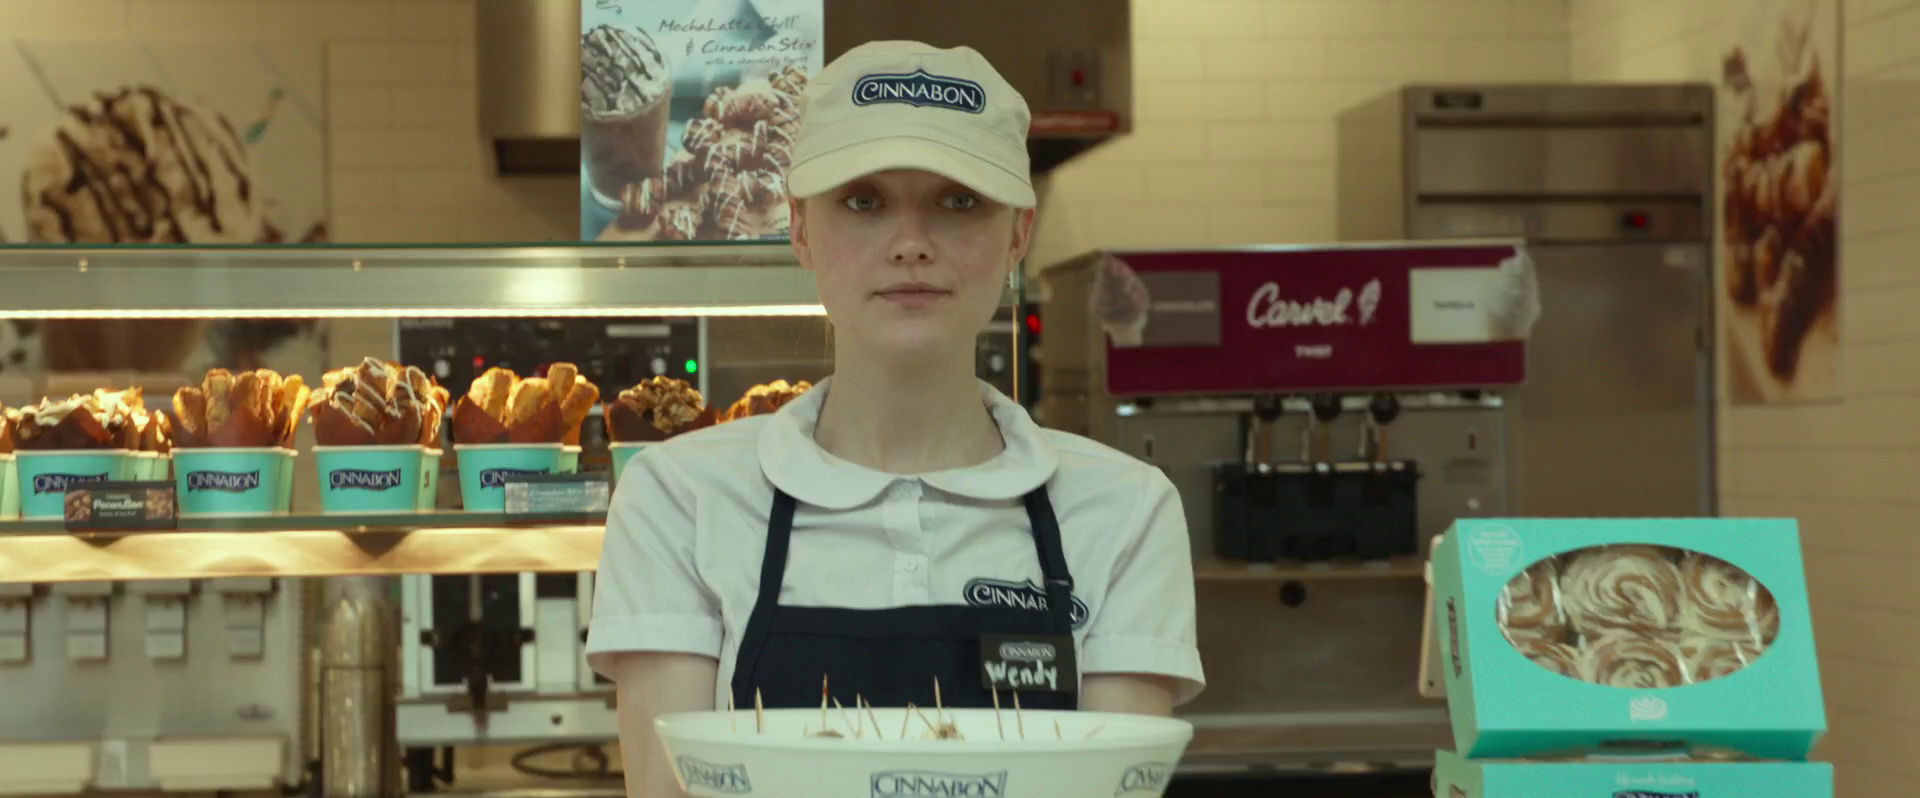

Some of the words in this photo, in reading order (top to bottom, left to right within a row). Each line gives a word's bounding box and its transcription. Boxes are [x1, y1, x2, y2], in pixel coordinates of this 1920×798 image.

[860, 81, 976, 107] CINNABON
[1247, 281, 1353, 328] Carvel
[188, 472, 258, 489] CINNABON
[331, 470, 400, 487] CINNABON
